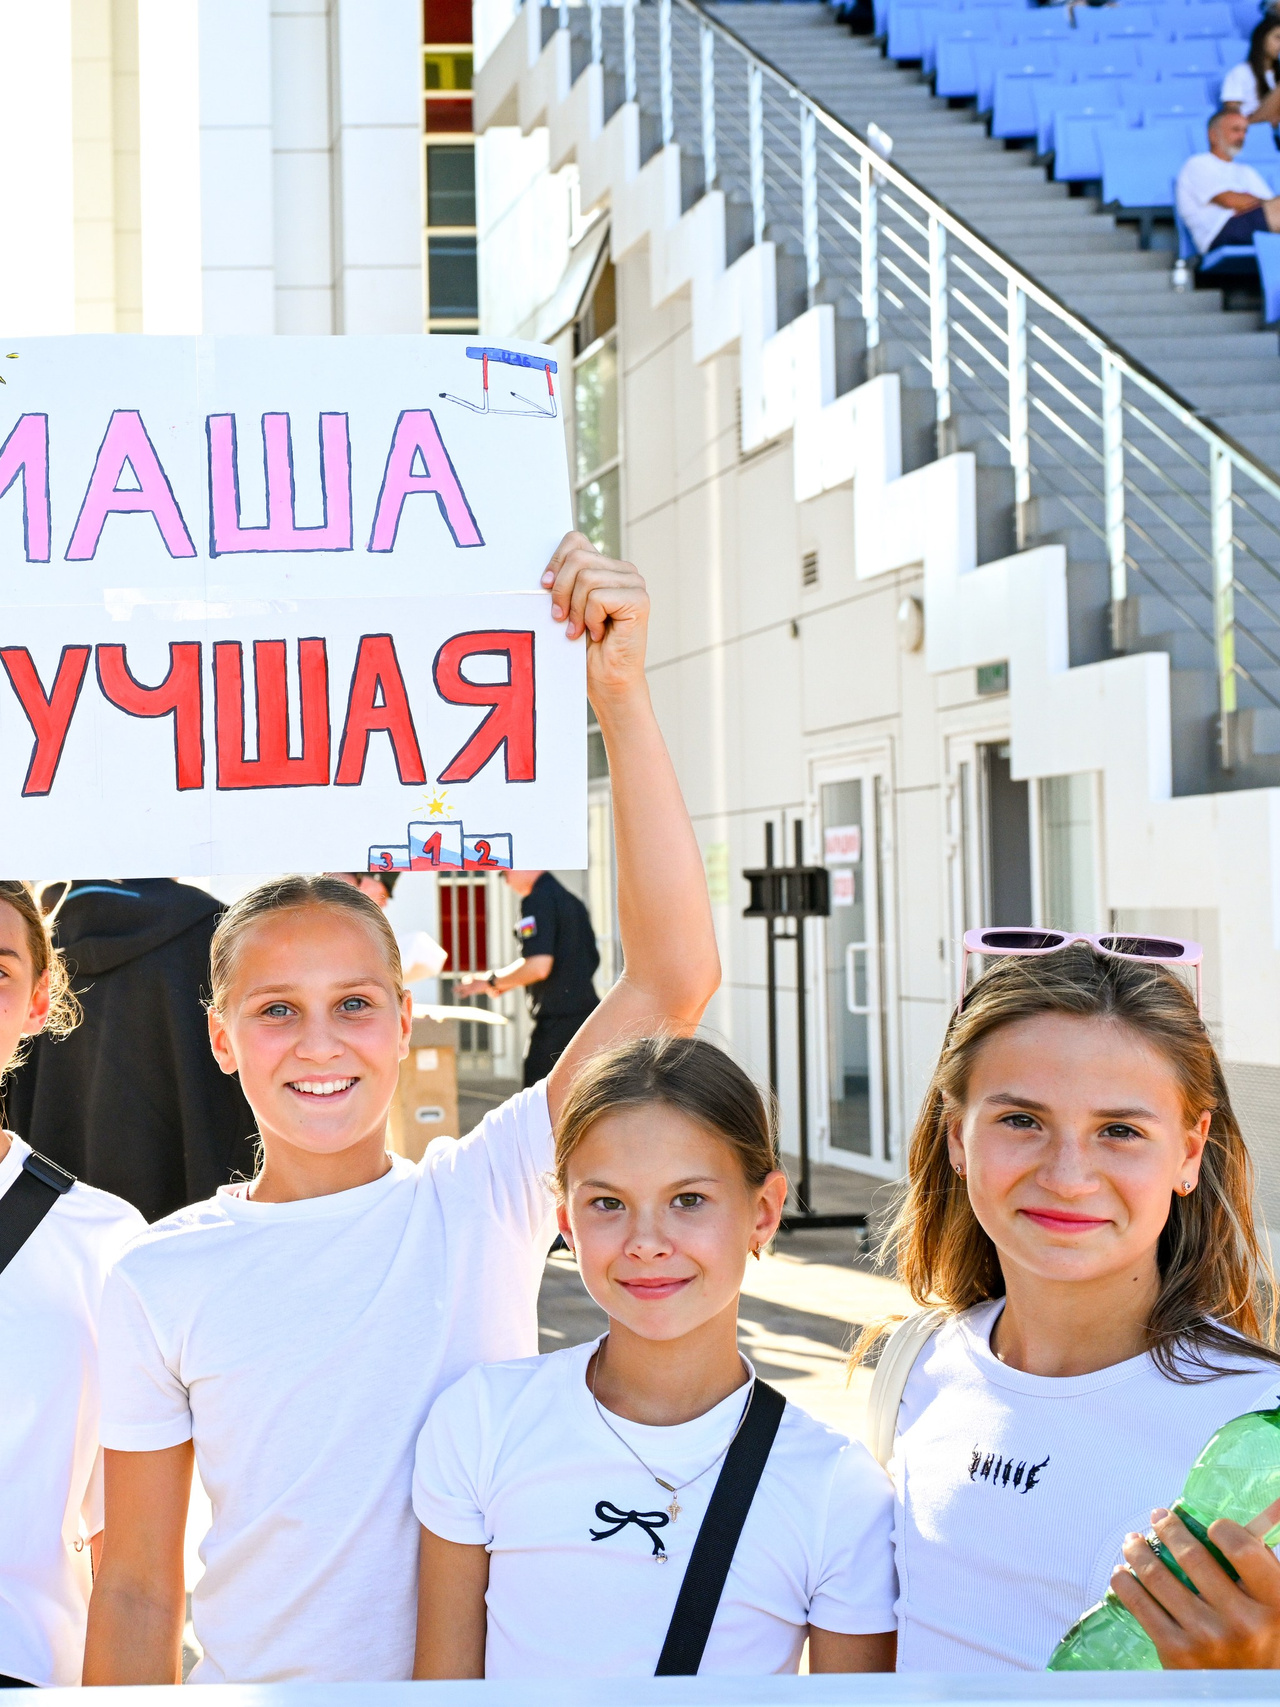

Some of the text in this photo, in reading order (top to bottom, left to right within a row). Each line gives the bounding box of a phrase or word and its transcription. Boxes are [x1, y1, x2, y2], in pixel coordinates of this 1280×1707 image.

[379, 831, 499, 871] 3 1 2
